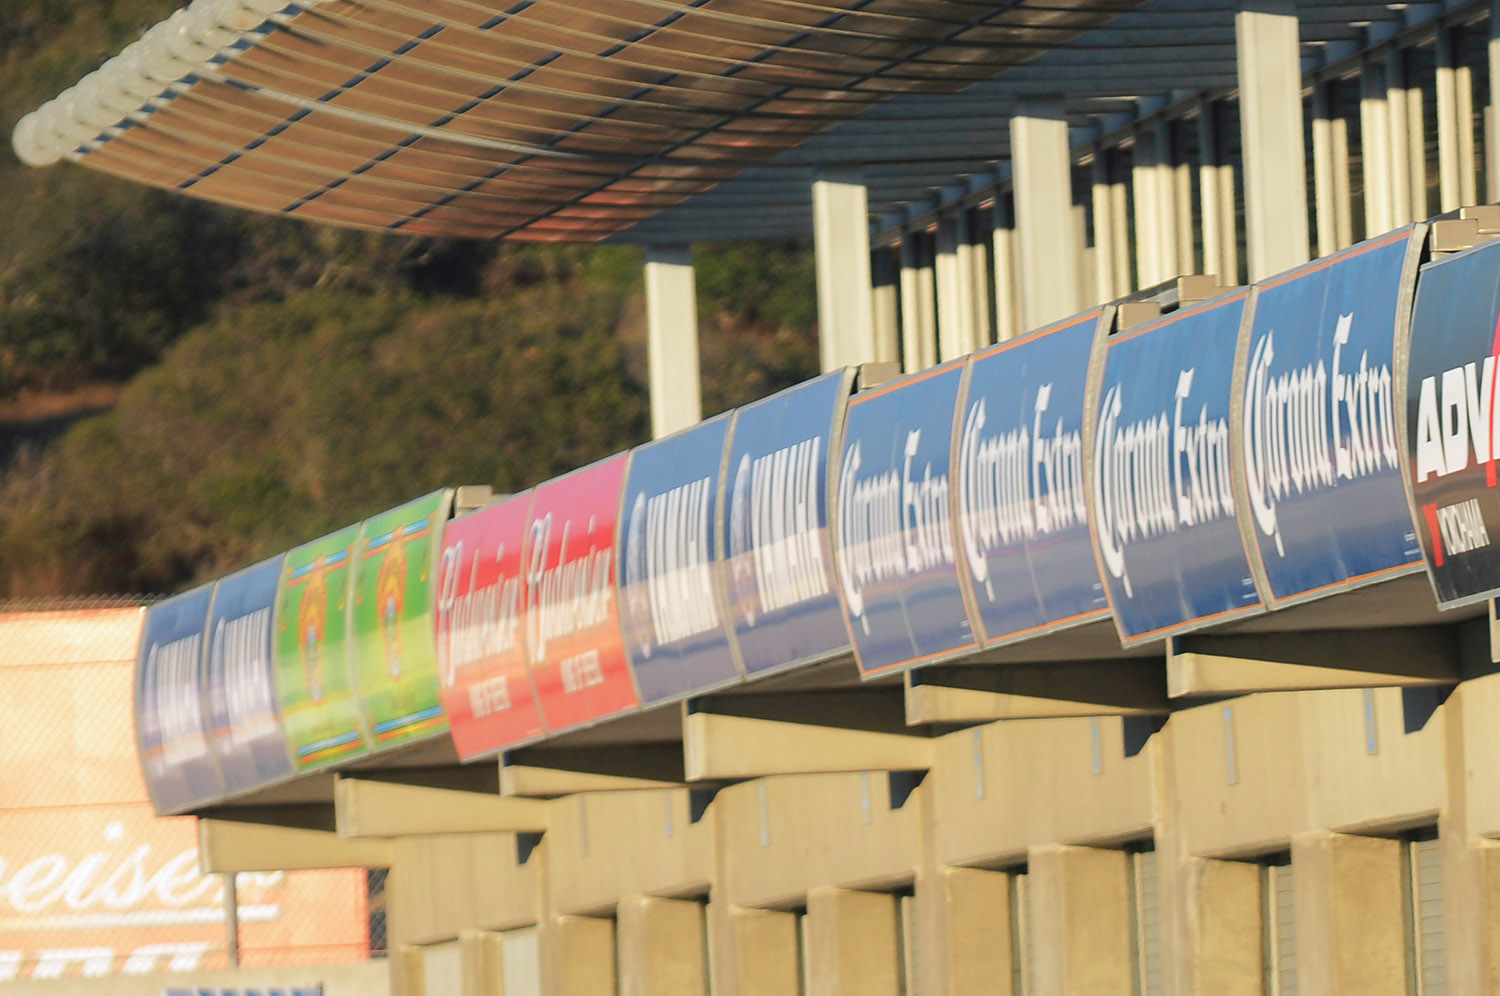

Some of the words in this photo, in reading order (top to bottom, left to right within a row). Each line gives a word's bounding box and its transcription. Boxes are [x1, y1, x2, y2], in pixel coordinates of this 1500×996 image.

[902, 427, 955, 574] Extra
[1032, 382, 1088, 534] Extra
[1095, 383, 1178, 599] Corona
[1174, 367, 1237, 528] Extra
[1243, 330, 1337, 557] Corona
[1331, 311, 1399, 481] Extra
